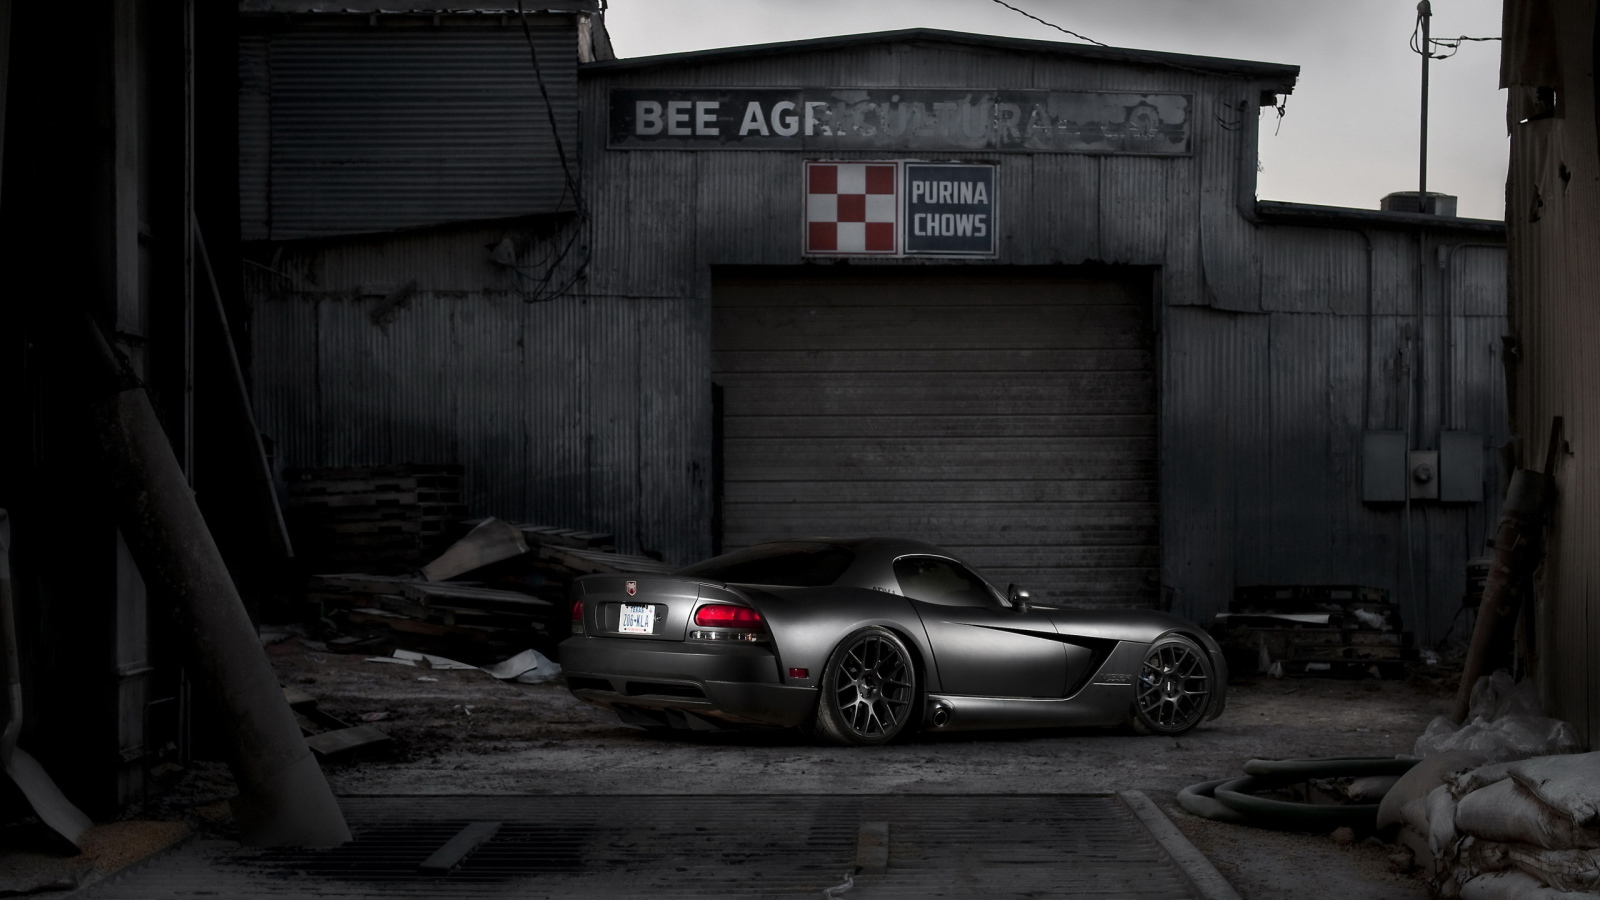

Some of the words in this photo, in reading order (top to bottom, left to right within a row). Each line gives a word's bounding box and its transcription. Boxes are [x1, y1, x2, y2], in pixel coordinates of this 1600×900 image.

[634, 100, 719, 136] BEE
[739, 100, 1081, 139] AGRICULTURA
[911, 180, 989, 205] PURINA
[913, 212, 988, 237] CHOWS
